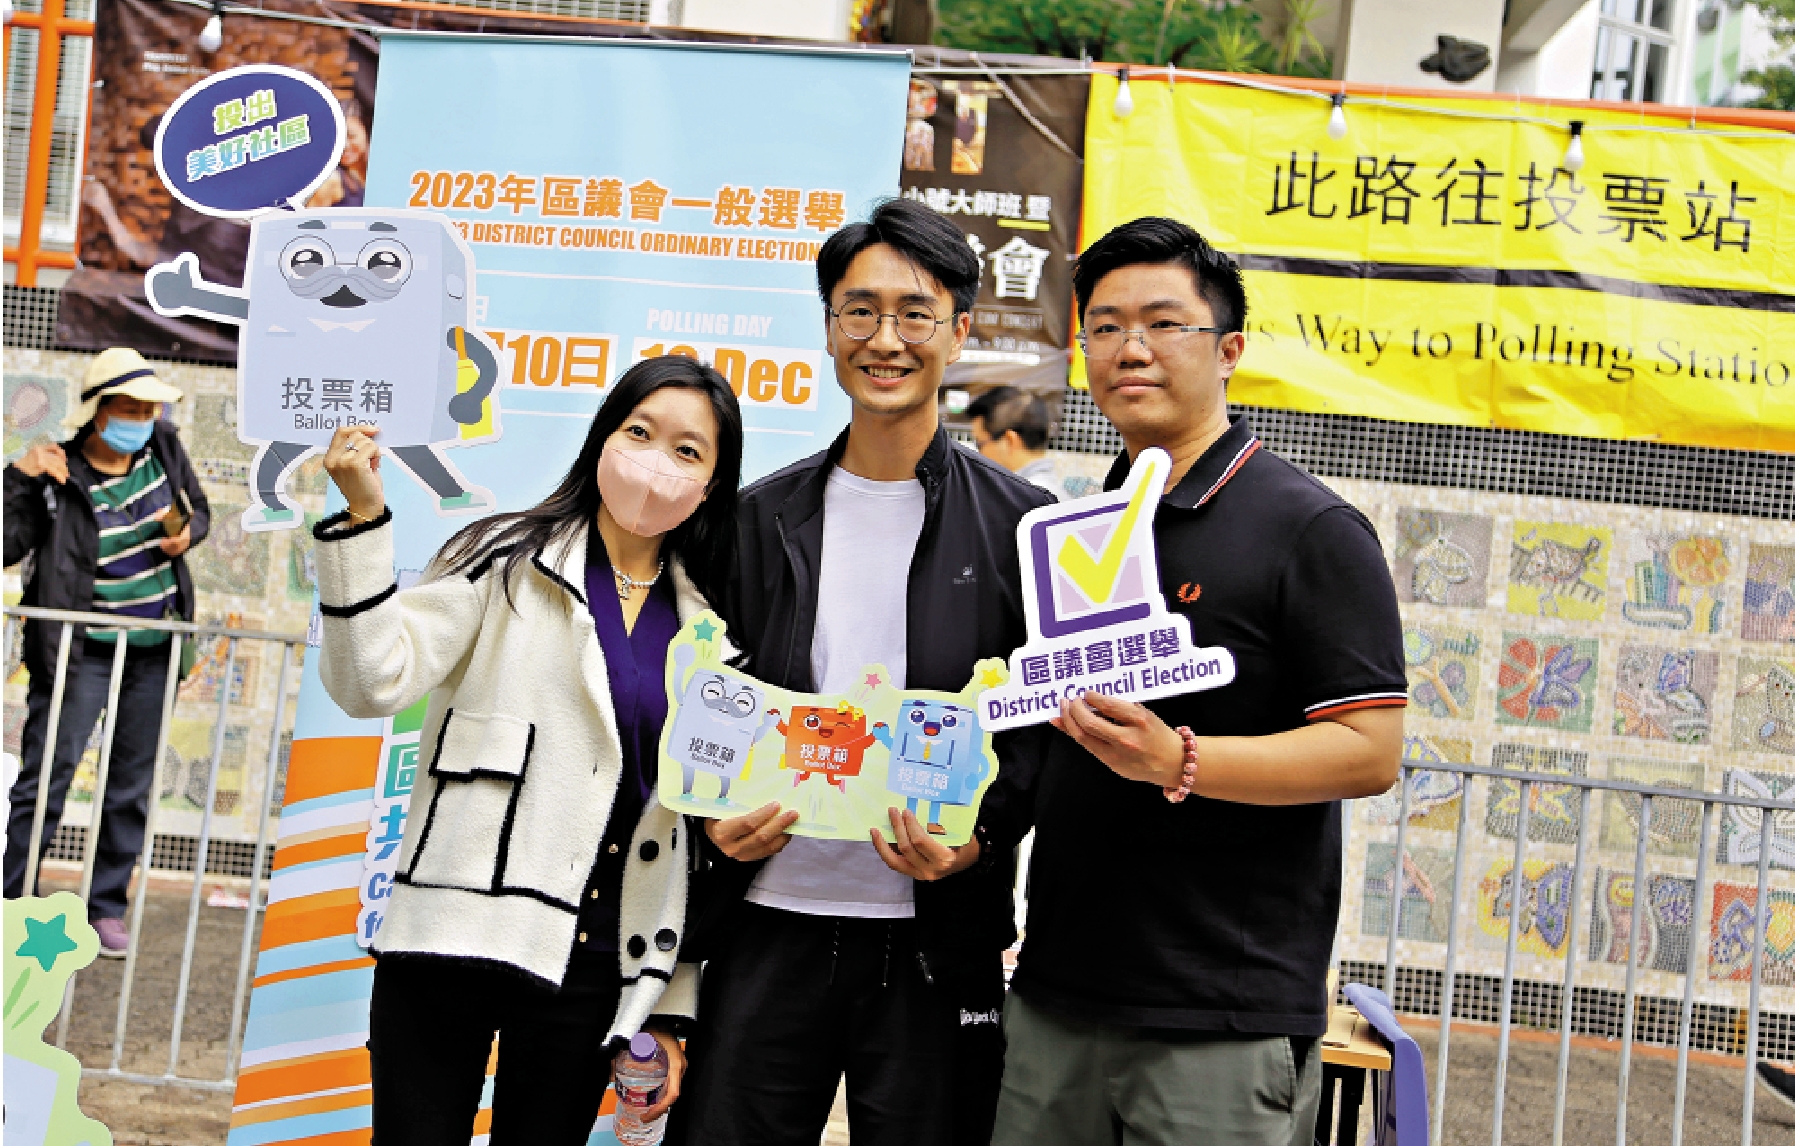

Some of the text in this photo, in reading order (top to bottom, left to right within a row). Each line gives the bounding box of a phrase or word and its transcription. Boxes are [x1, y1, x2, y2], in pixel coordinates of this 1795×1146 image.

[214, 90, 276, 134] 投出
[188, 115, 311, 181] 美好社區
[410, 171, 845, 231] 2023年區議會一般選舉
[1265, 150, 1757, 252] 此路往投票站
[473, 223, 557, 246] DISTRICT
[560, 227, 636, 250] COUNCIL
[640, 234, 734, 259] ORDINARY
[737, 237, 821, 261] ELECTION
[647, 308, 773, 338] POLLING DAY
[1296, 313, 1392, 367] Way
[1412, 326, 1452, 359] to
[1474, 322, 1636, 383] Polling
[484, 331, 611, 388] 10日
[714, 348, 812, 405] Dec
[281, 377, 394, 414] 投票箱
[294, 413, 341, 430] Ballot
[1021, 627, 1180, 686] 區議會選舉
[988, 688, 1058, 721] District
[1141, 657, 1221, 690] Election
[688, 736, 736, 764] 投票箱
[800, 743, 849, 764] 投票箱
